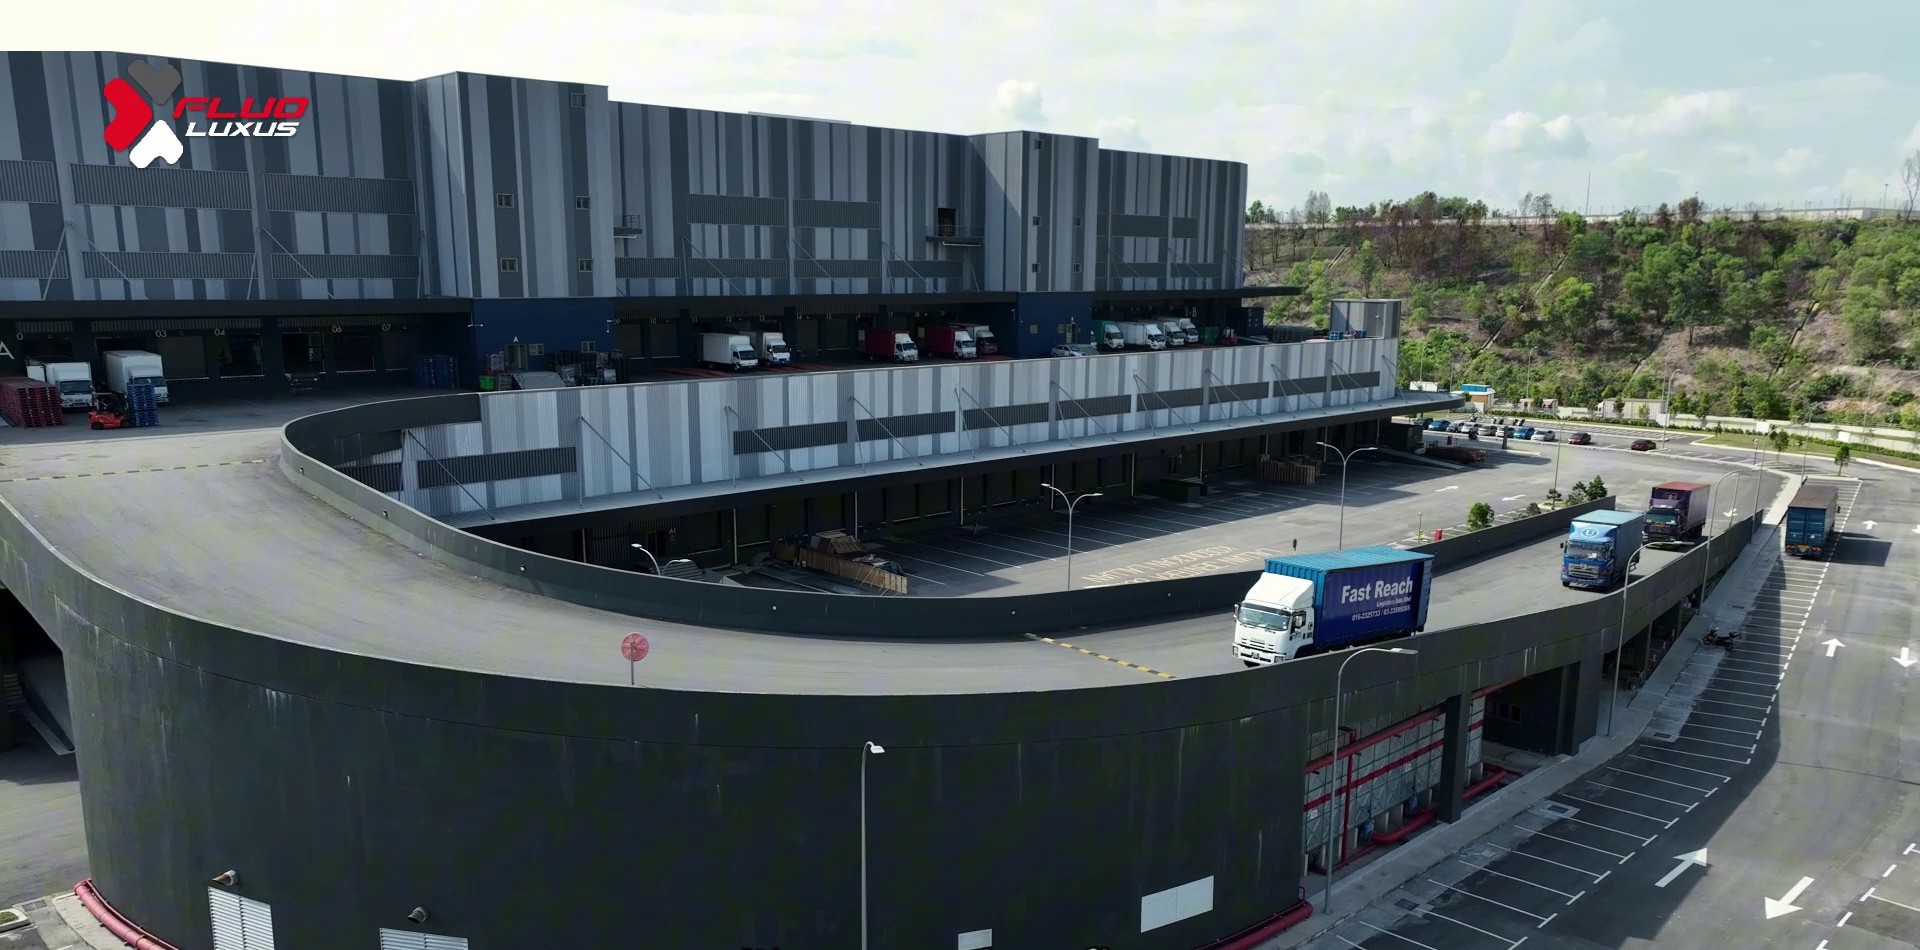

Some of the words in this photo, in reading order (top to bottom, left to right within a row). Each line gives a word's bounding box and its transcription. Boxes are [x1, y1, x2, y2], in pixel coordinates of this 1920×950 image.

[214, 328, 226, 336] 04
[331, 325, 342, 333] 06
[381, 324, 392, 332] 07
[155, 329, 167, 338] 03
[1341, 582, 1371, 604] Fast
[1375, 576, 1413, 598] Reach
